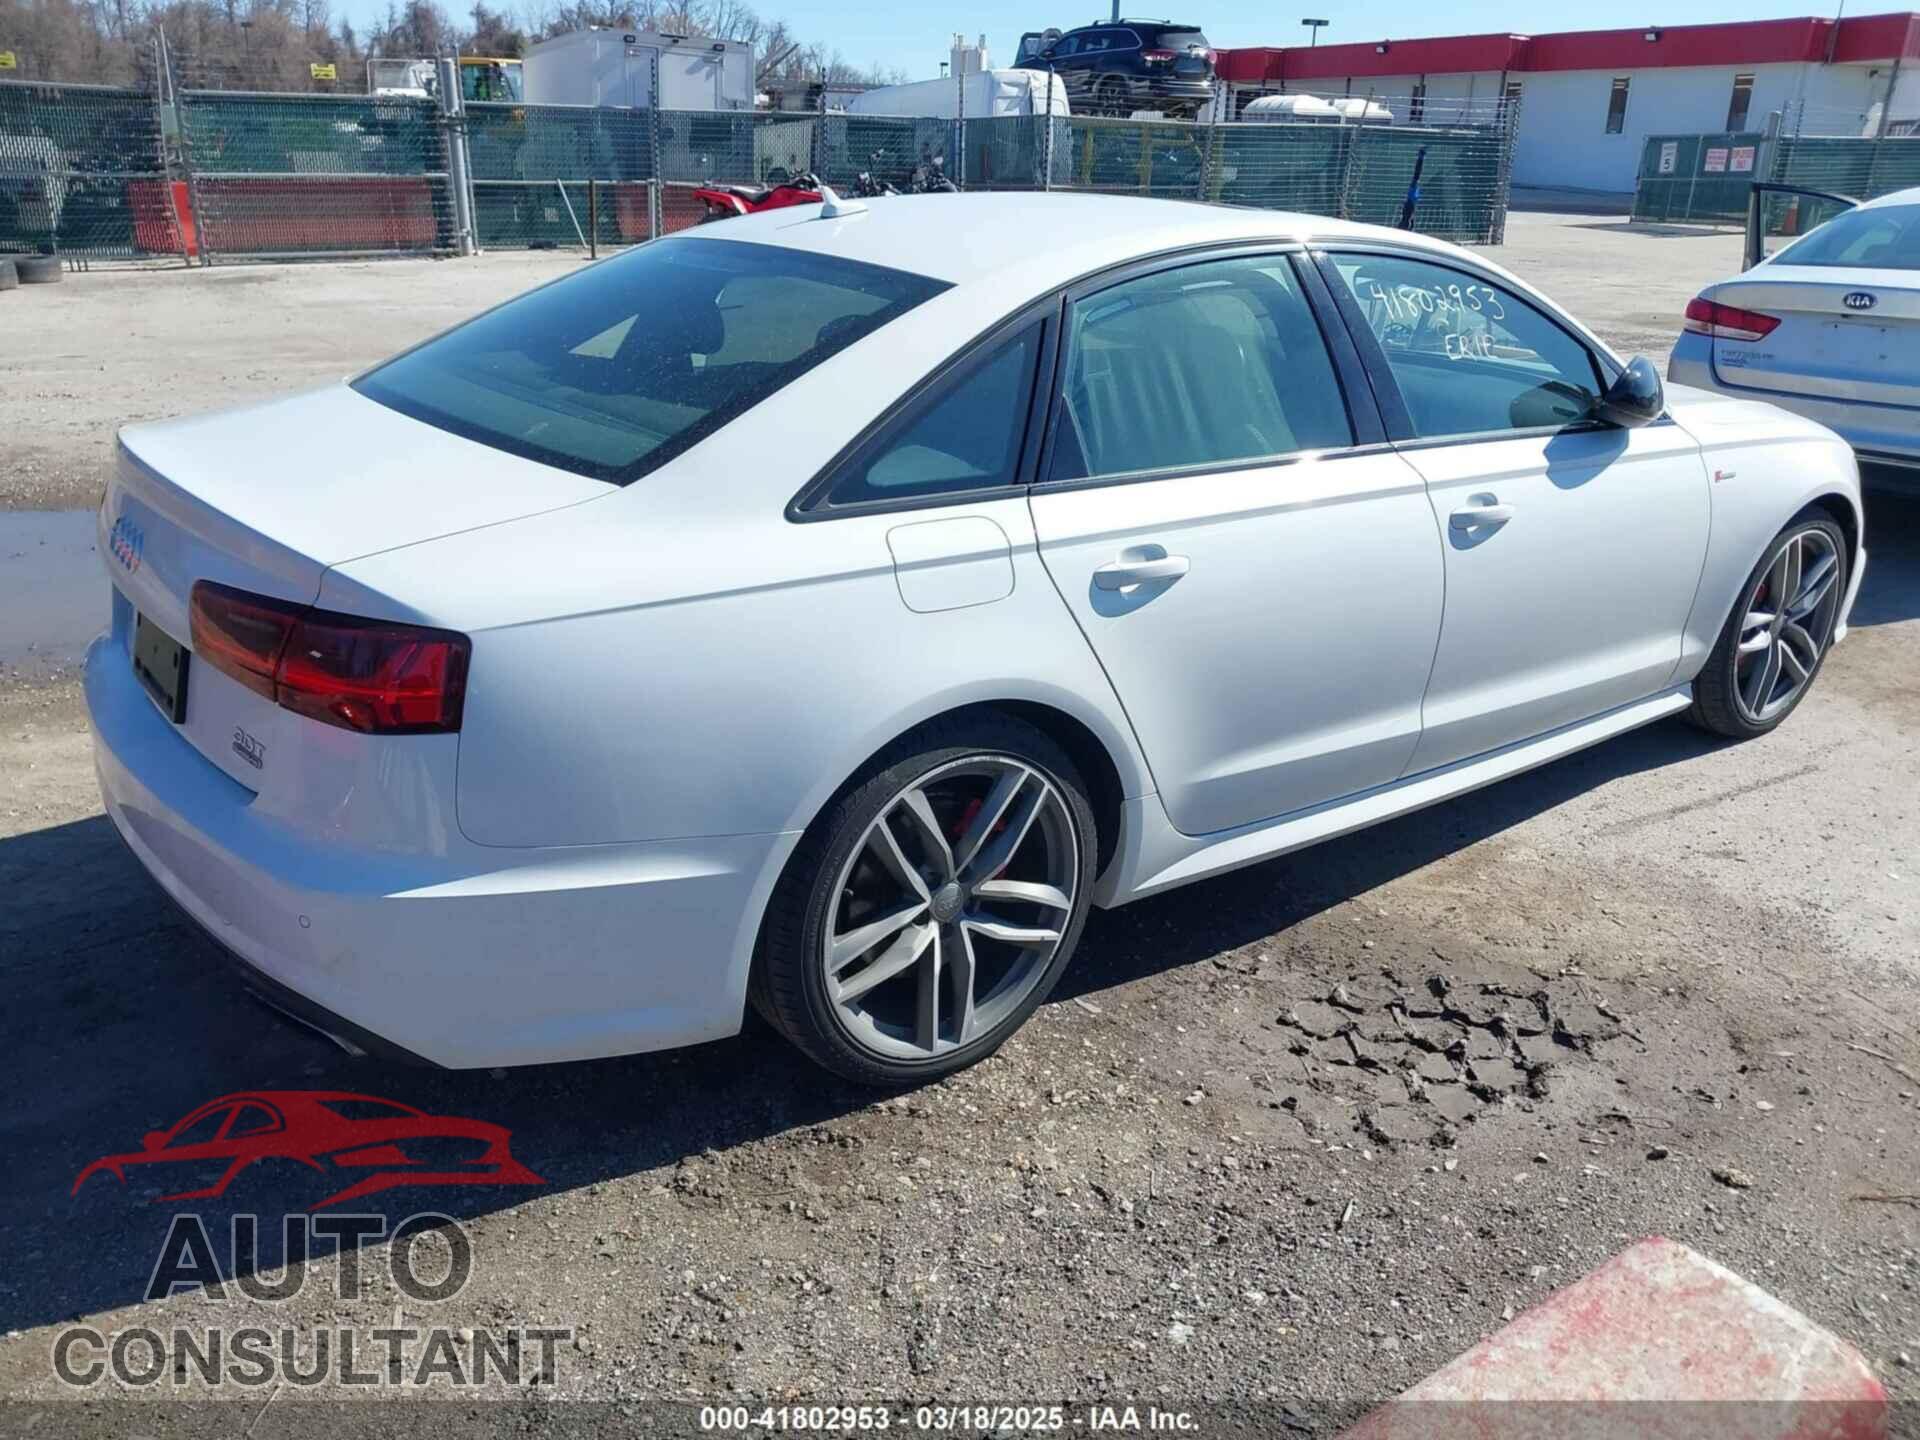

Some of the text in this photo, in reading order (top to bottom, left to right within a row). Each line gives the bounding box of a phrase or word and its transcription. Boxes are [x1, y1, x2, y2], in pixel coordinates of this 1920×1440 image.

[1663, 158, 1671, 170] 5
[1369, 283, 1505, 321] 41802953
[1845, 294, 1872, 309] KIA
